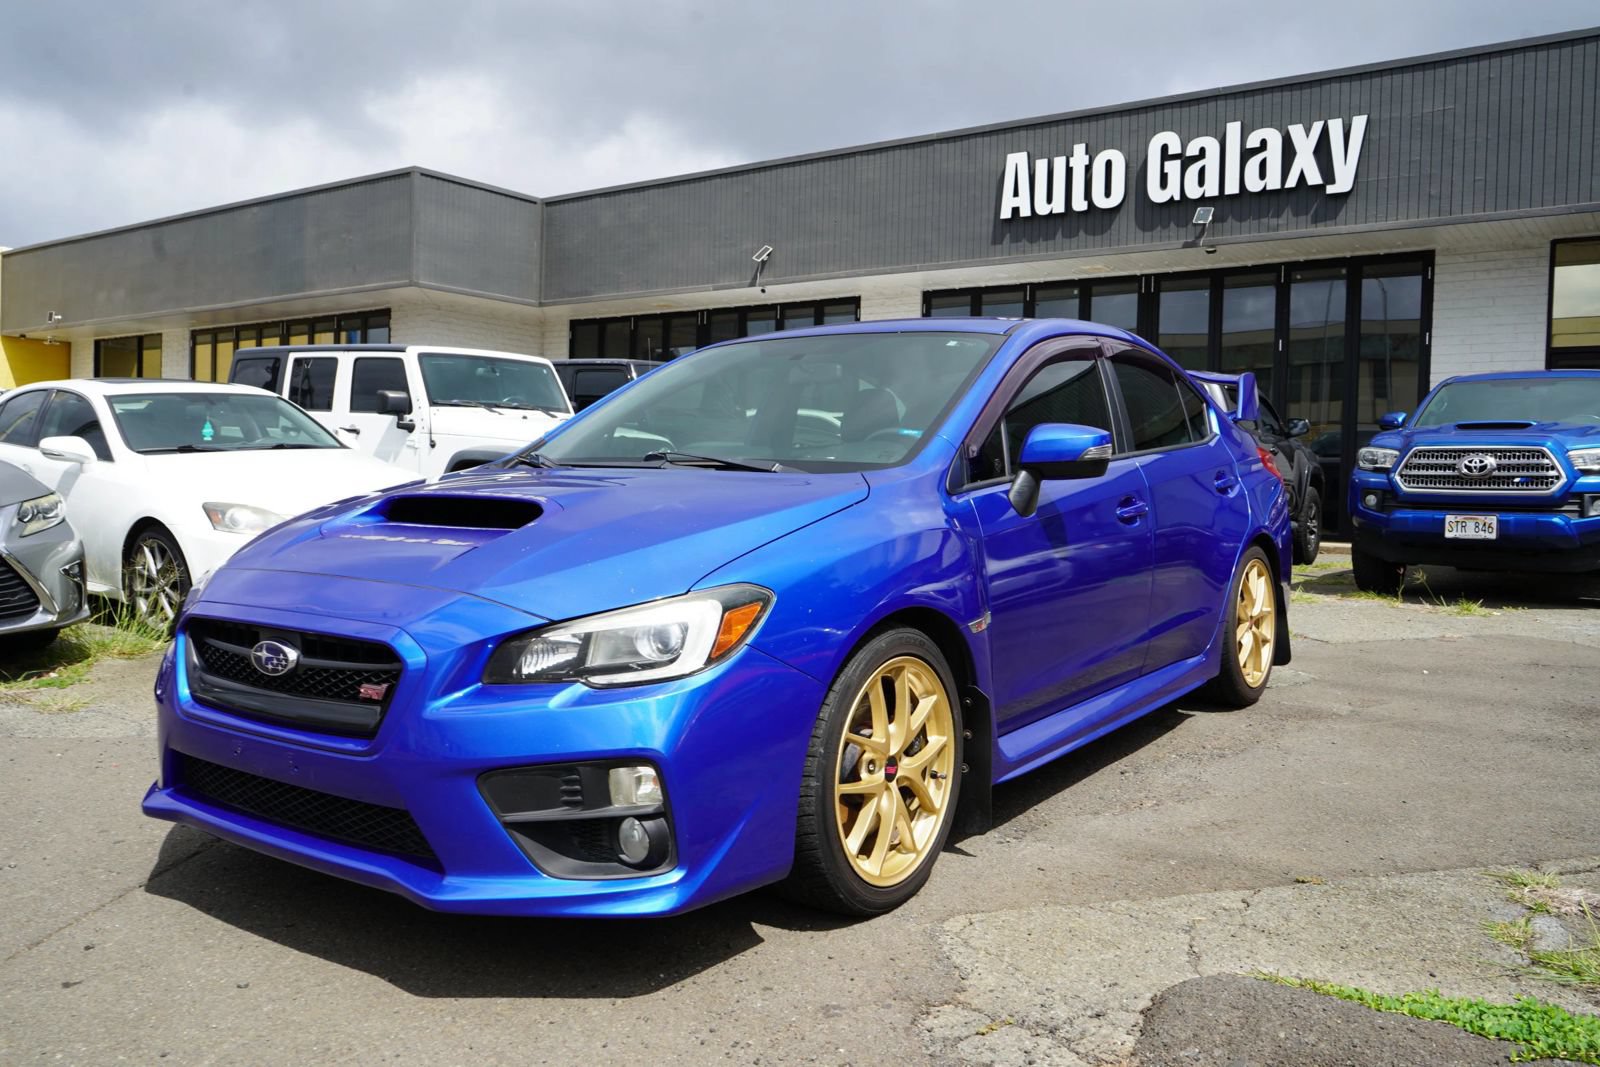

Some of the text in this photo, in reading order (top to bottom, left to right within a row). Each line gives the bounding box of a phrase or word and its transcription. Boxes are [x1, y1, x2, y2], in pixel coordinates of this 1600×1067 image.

[1000, 114, 1369, 220] Auto Galaxy
[1447, 520, 1495, 534] STR 846
